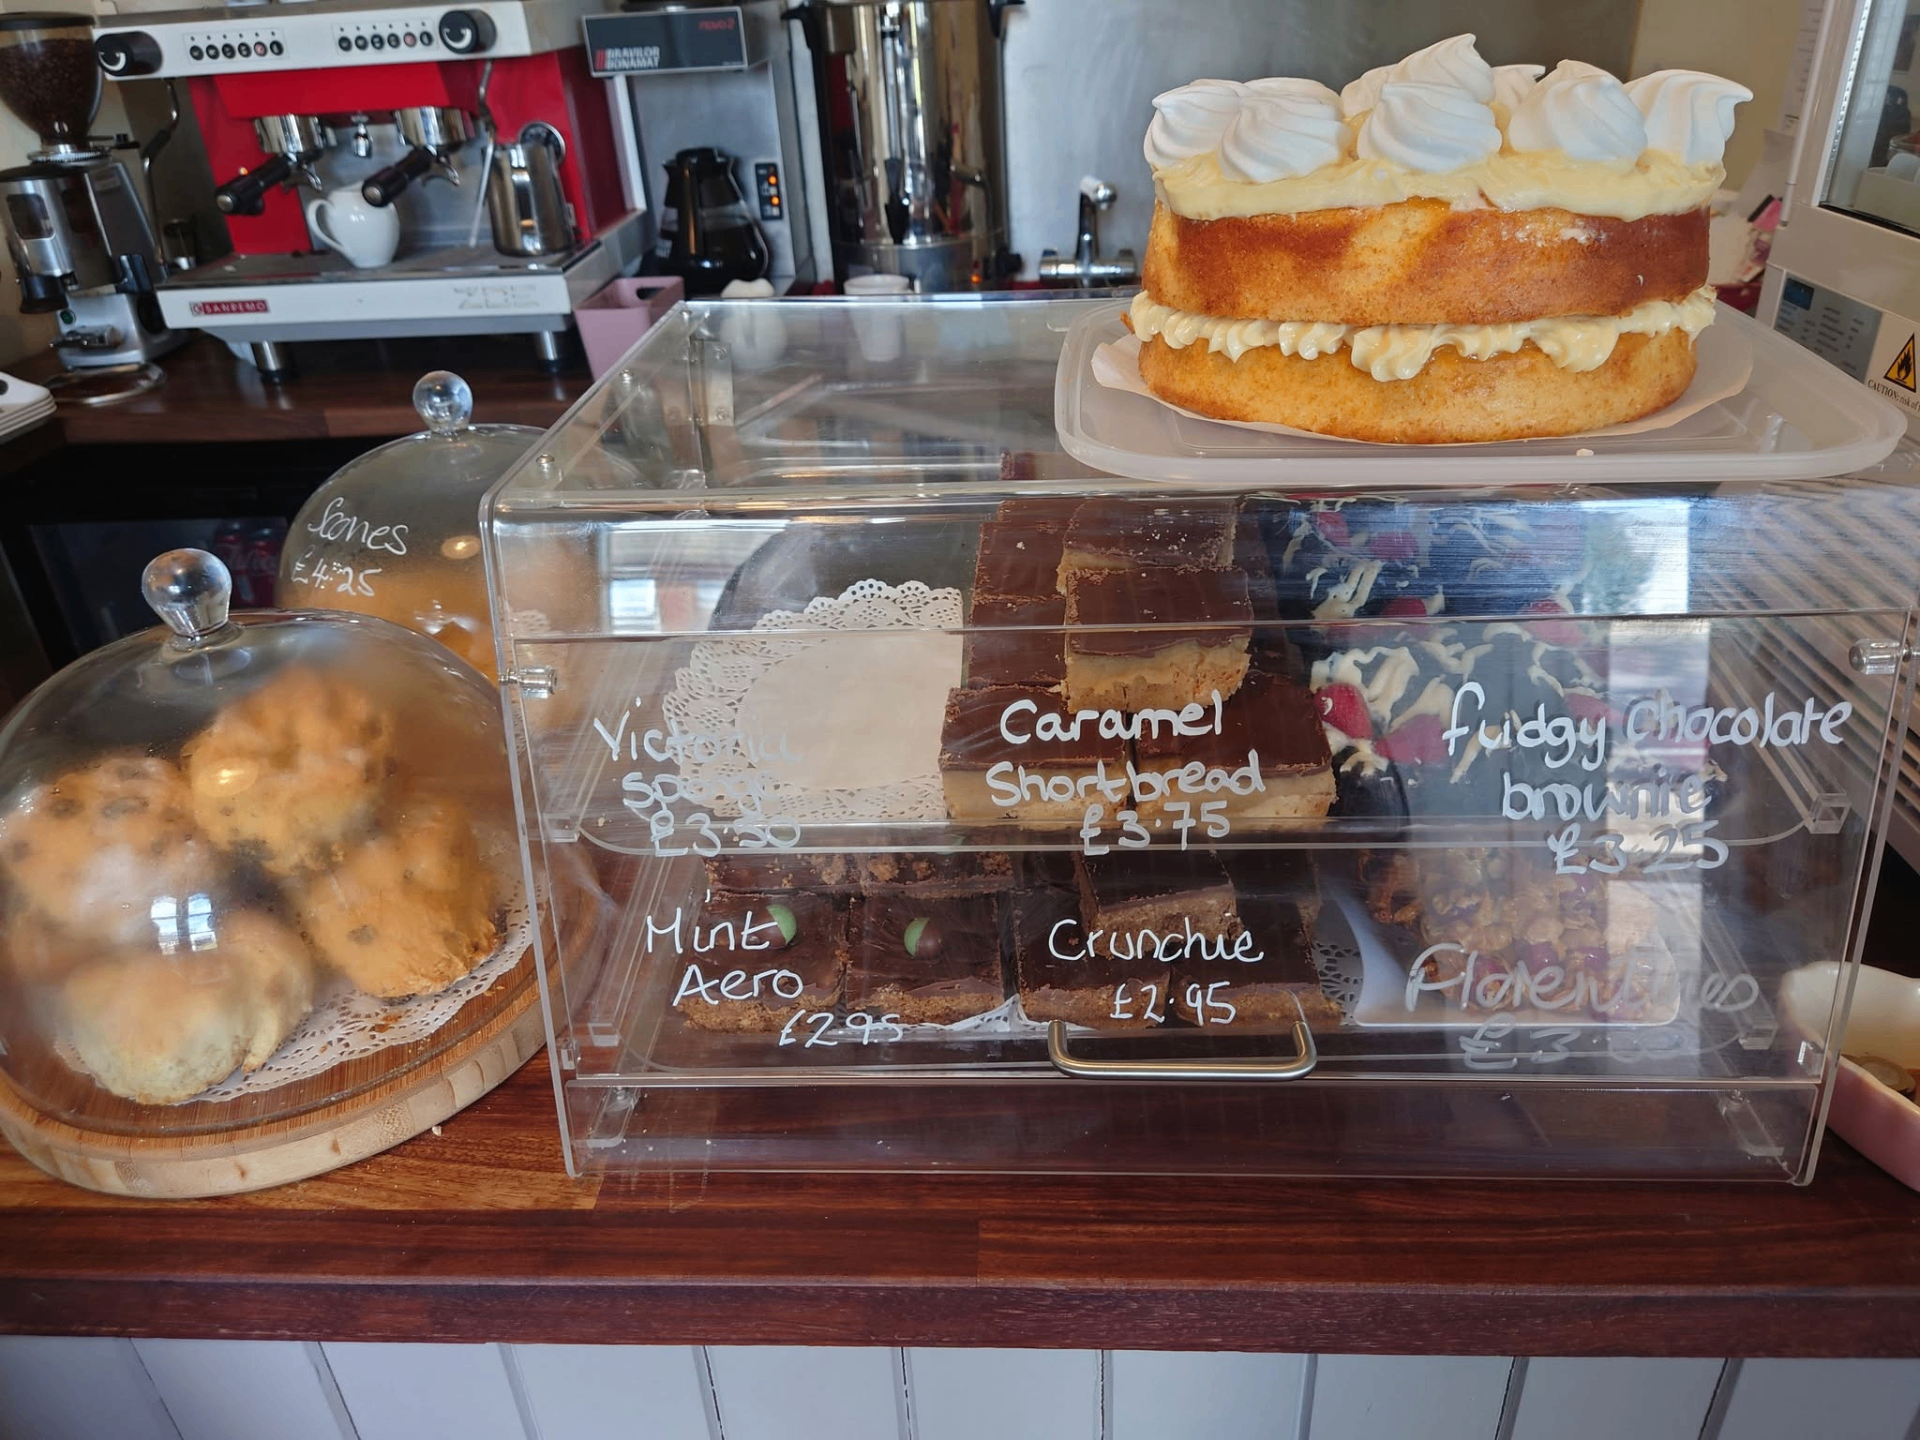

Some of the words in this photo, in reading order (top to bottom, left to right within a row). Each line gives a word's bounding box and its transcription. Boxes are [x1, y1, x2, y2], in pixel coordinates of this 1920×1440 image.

[606, 46, 660, 59] BRAVILOR
[606, 57, 659, 70] BONAMAT
[1867, 379, 1899, 401] CAUTION:
[1000, 689, 1223, 745] Caramel
[1442, 681, 1607, 771] fudgy
[986, 748, 1266, 806] Shortbread
[1502, 766, 1712, 822] brownie
[1079, 800, 1231, 856] £3.75
[1547, 820, 1730, 876] £3.25
[646, 888, 779, 954] Mint
[1047, 912, 1265, 963] Crunchie
[672, 964, 804, 1006] Aero
[1110, 981, 1237, 1027] £2.95
